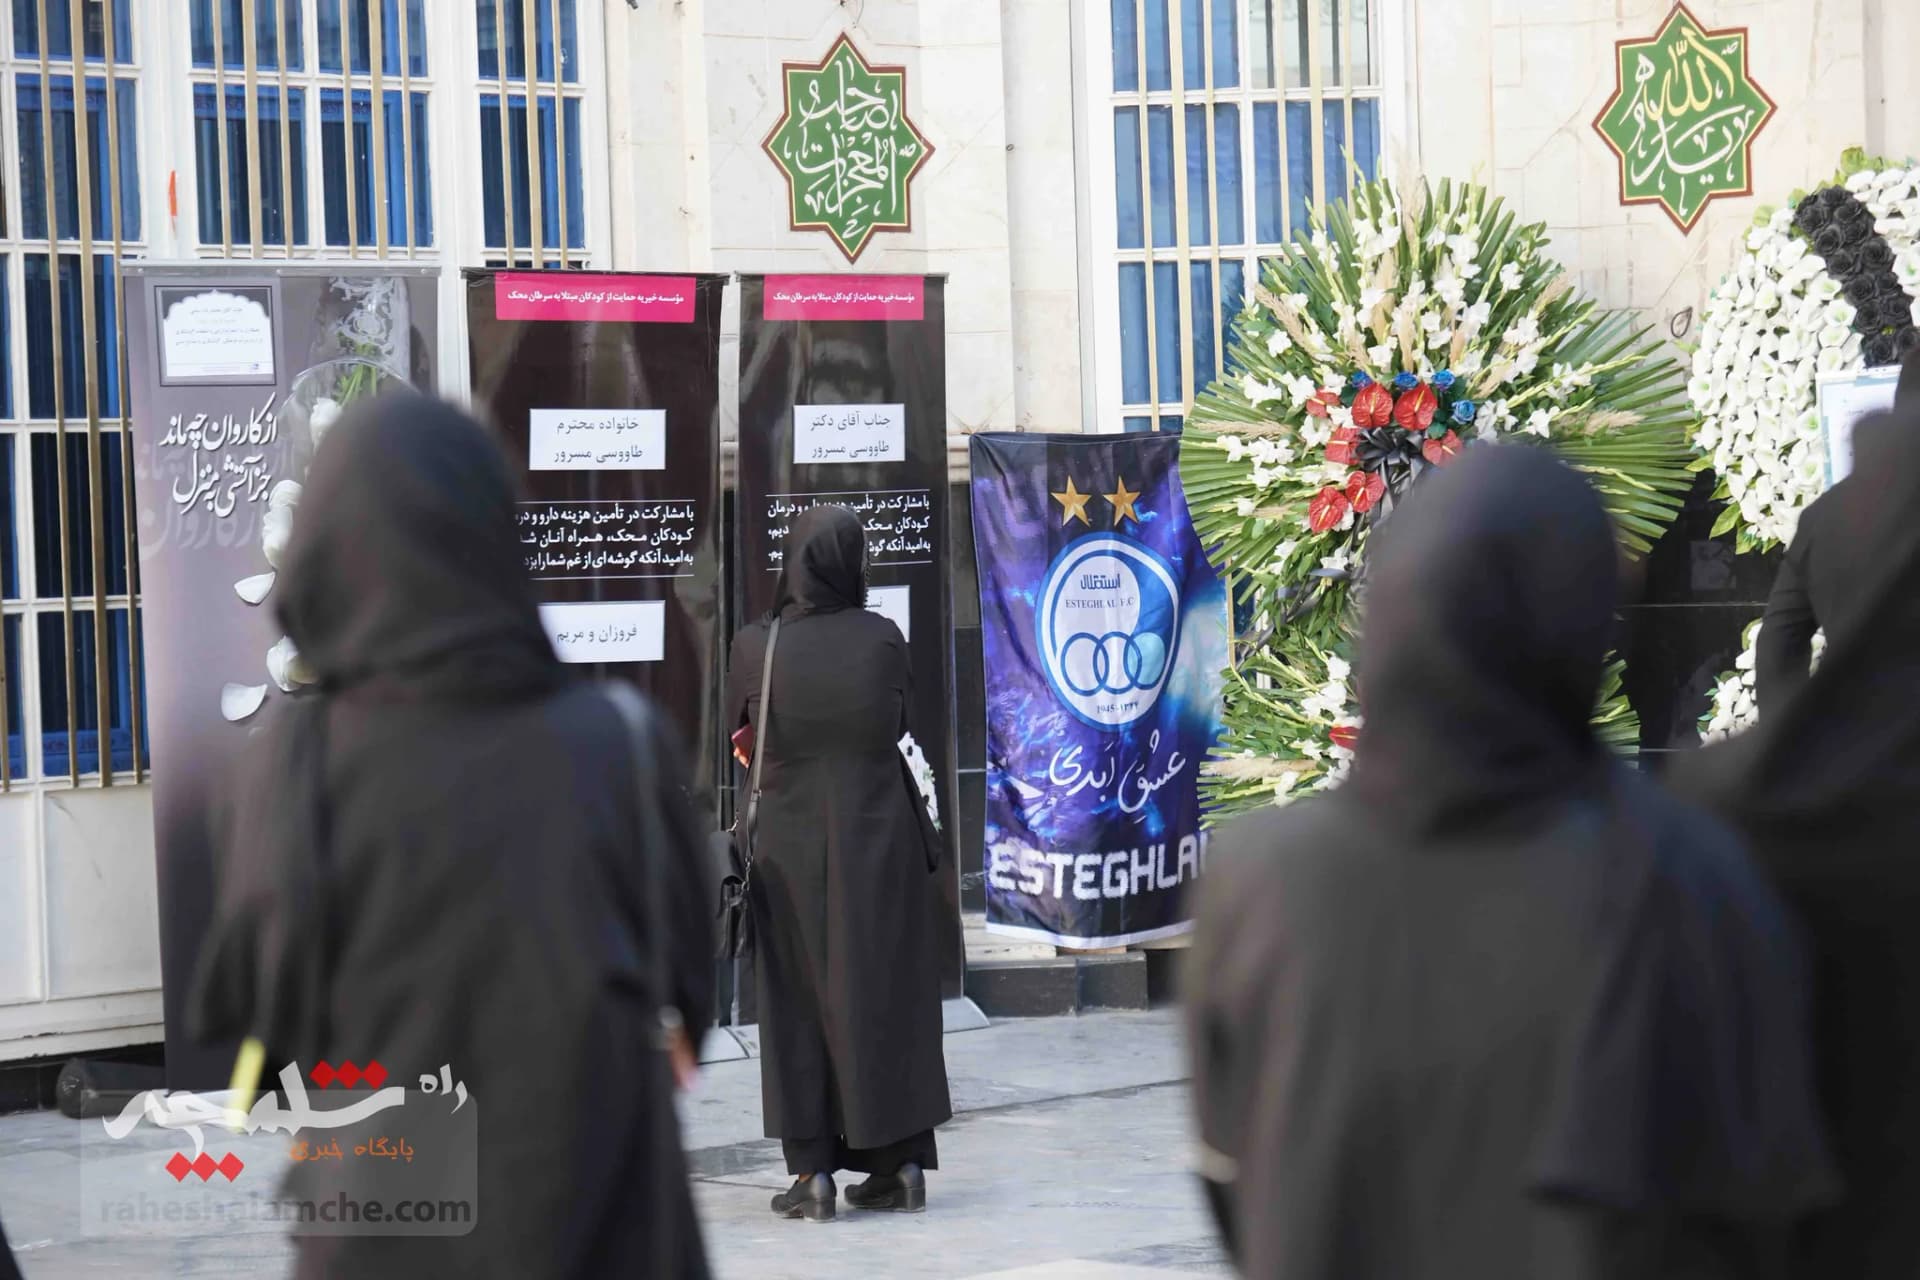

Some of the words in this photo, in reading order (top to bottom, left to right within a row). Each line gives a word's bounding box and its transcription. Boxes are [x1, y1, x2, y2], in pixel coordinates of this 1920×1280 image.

[508, 290, 528, 299] محک
[529, 290, 553, 302] سرطان
[553, 293, 560, 302] به
[560, 291, 578, 302] مبتلا
[579, 291, 605, 303] کودکان
[605, 292, 612, 303] از
[612, 292, 636, 303] حمایت
[637, 293, 657, 304] خیریه
[773, 292, 790, 300] محک
[790, 292, 811, 303] سرطان
[817, 292, 832, 303] مبتلا
[832, 292, 853, 303] کودکان
[853, 292, 858, 303] از
[859, 292, 877, 303] حمایت
[878, 293, 894, 303] خیریه
[202, 392, 276, 450] کاروان
[260, 412, 277, 444] از
[557, 419, 594, 435] محترم
[599, 417, 639, 434] خانواده
[810, 414, 834, 431] دکتر
[838, 410, 860, 430] آقای
[864, 412, 891, 430] جناب
[159, 413, 187, 446] ماند
[185, 413, 208, 450] چه
[554, 449, 591, 463] مسرور
[596, 445, 643, 463] طاووسی
[812, 446, 846, 458] مسرور
[850, 440, 889, 458] طاووسی
[173, 450, 220, 515] منزل
[214, 454, 263, 518] آتشی
[203, 487, 217, 511] به
[875, 500, 886, 513] در
[887, 495, 922, 512] مشارکت
[923, 494, 929, 510] با
[539, 506, 559, 525] دارو
[593, 502, 624, 524] تأمین
[641, 505, 685, 523] مشارکت
[686, 505, 694, 521] با
[768, 499, 795, 518] درمان
[797, 505, 802, 517] و
[532, 513, 537, 525] و
[561, 510, 591, 524] هزینه
[625, 510, 639, 524] در
[895, 516, 930, 534] کودکان
[540, 527, 565, 548] آنان
[568, 529, 603, 547] همراه
[651, 527, 694, 546] کودکان
[886, 536, 904, 552] آنکه
[905, 537, 922, 553] امید
[923, 541, 931, 553] به
[538, 552, 546, 571] را
[546, 552, 566, 566] شما
[566, 552, 581, 570] غم
[581, 551, 591, 570] از
[638, 548, 661, 564] آنکه
[662, 549, 683, 566] امید
[684, 552, 694, 566] به
[1081, 573, 1120, 590] استقلال
[1065, 600, 1117, 609] ESTEGHLAL
[557, 630, 584, 644] مریم
[588, 631, 594, 642] و
[598, 623, 637, 643] فروزان
